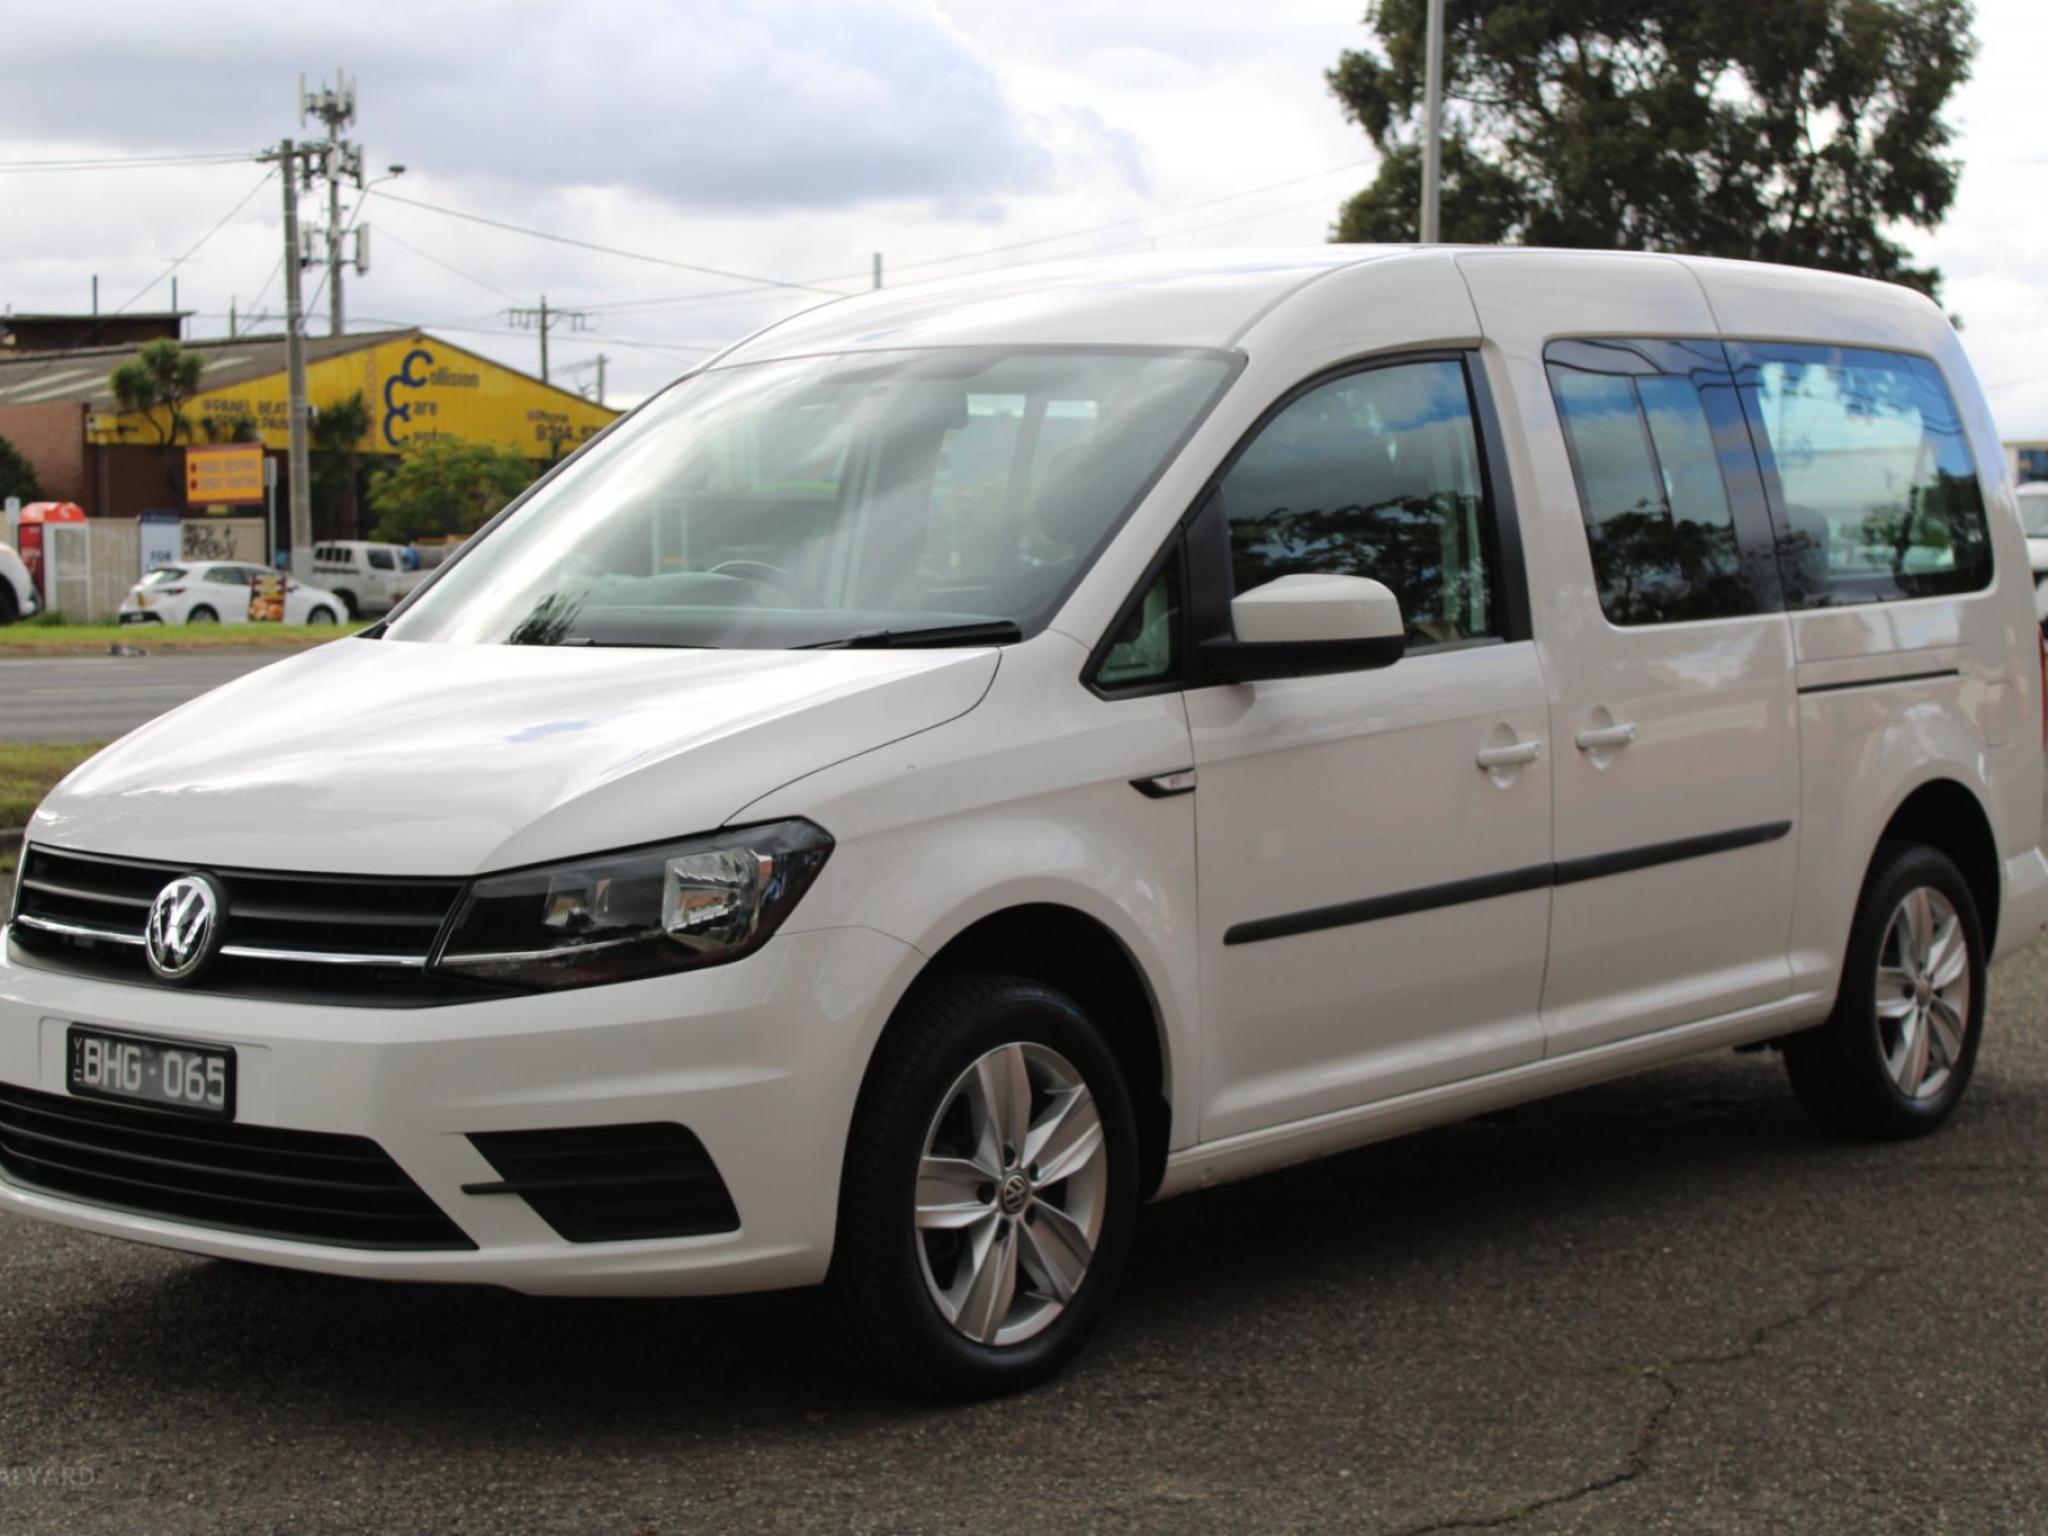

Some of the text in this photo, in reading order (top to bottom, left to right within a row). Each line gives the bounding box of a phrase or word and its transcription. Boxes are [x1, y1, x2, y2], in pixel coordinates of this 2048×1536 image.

[402, 349, 479, 388] Collision
[213, 399, 289, 415] PANEL BEAT
[384, 374, 438, 415] Care
[536, 410, 568, 423] Phone
[150, 551, 171, 561] FOR
[72, 1036, 83, 1082] VIC
